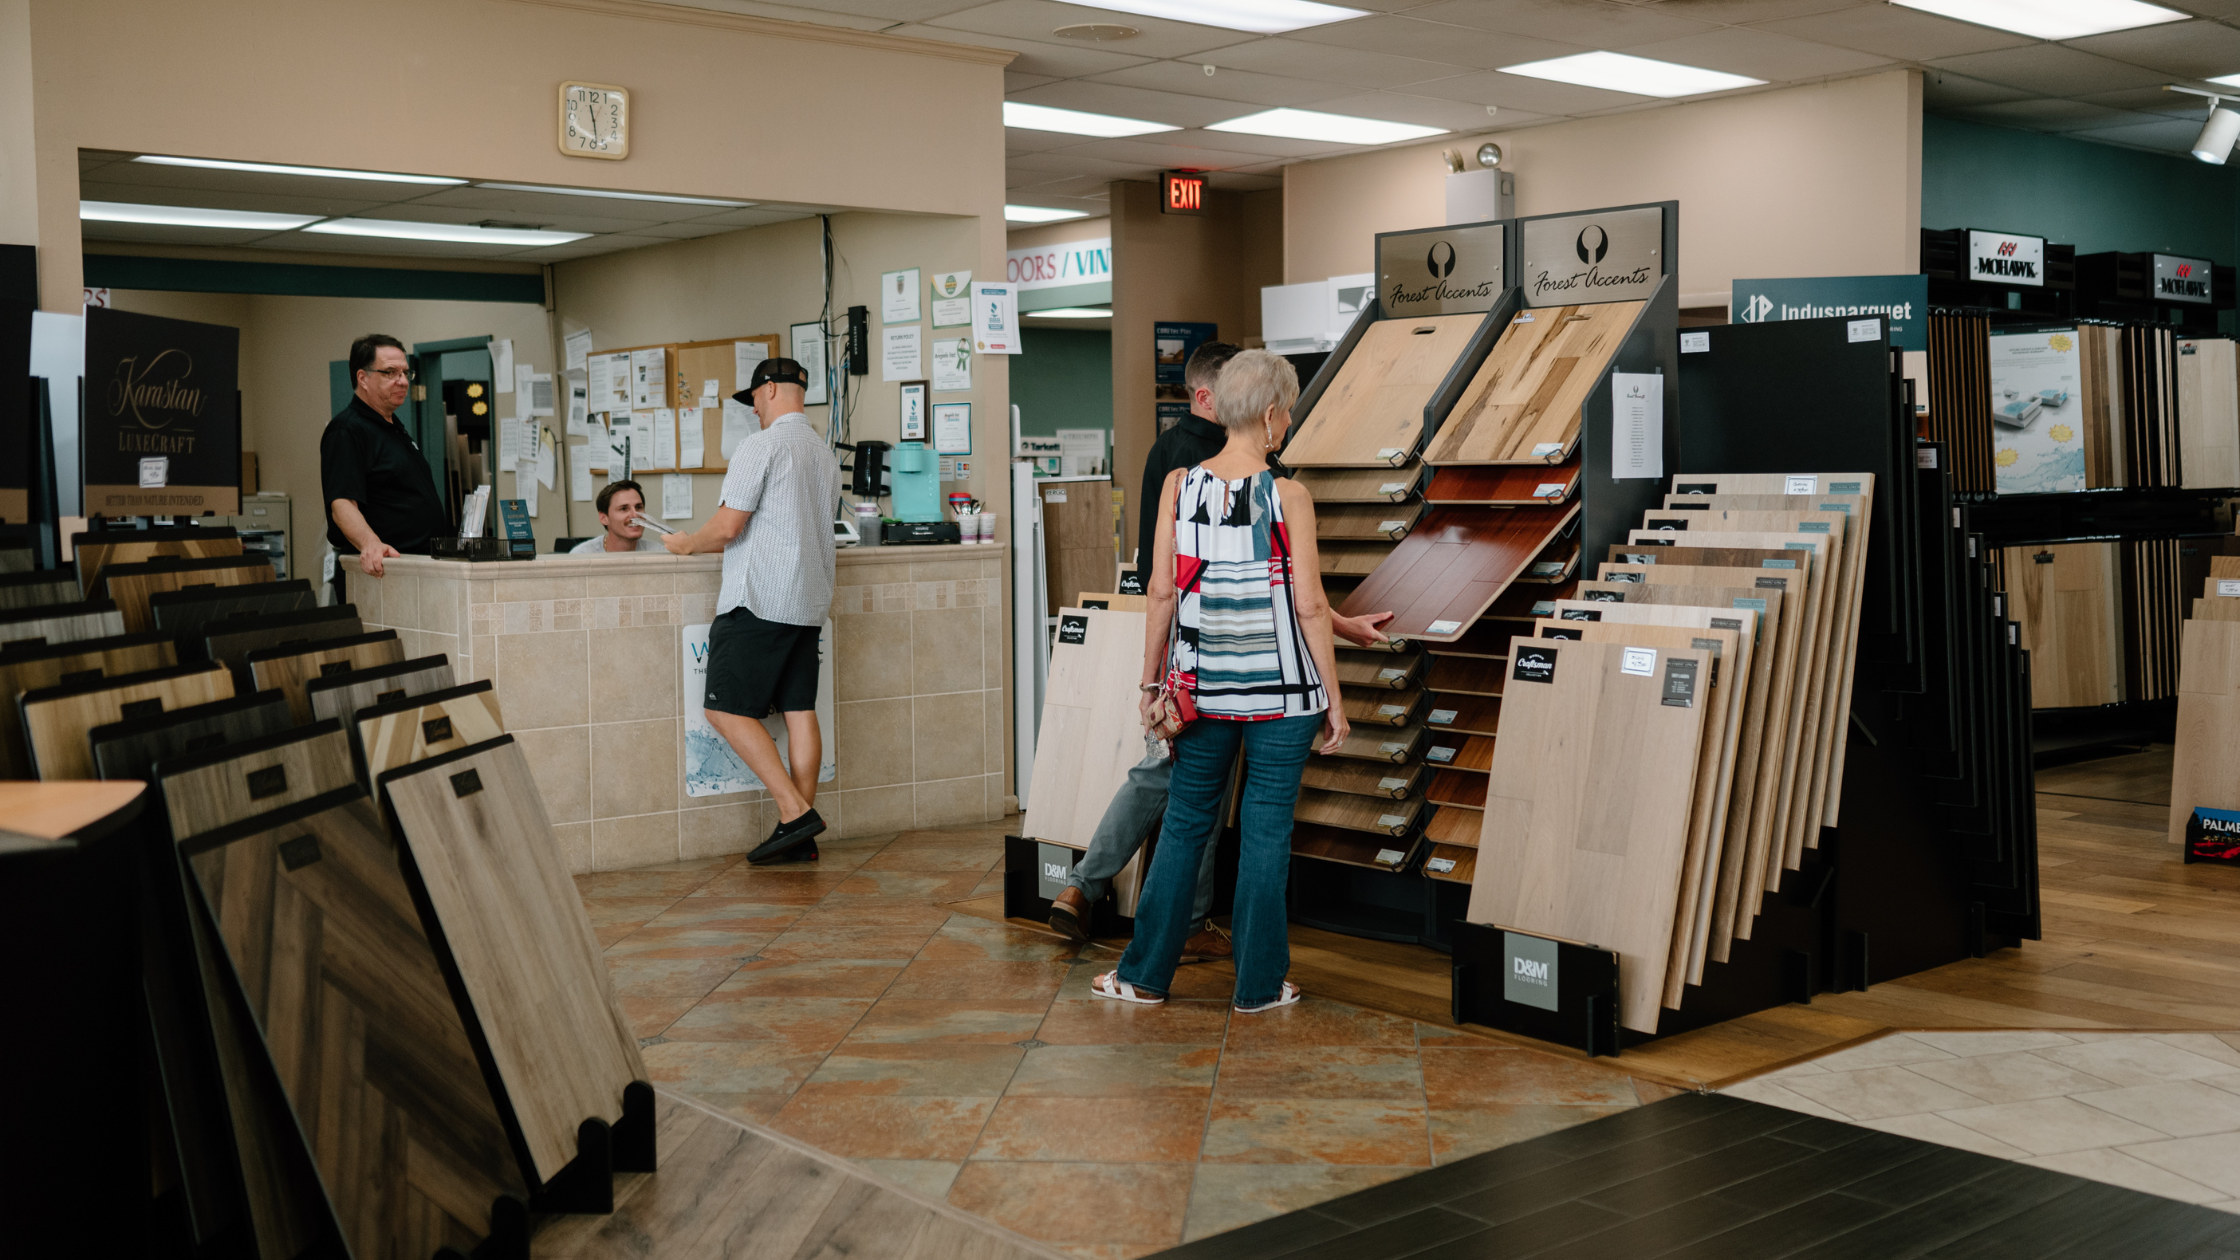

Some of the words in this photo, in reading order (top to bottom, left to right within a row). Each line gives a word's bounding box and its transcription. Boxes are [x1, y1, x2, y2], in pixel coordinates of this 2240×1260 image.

[578, 90, 586, 102] 11
[589, 92, 600, 104] 12
[567, 99, 578, 111] 10
[611, 104, 618, 116] 2
[611, 117, 618, 129] 3
[568, 126, 576, 138] 8
[610, 130, 618, 140] 4
[579, 137, 586, 148] 7
[589, 139, 597, 150] 6
[600, 139, 608, 150] 5
[1170, 178, 1203, 210] EXIT
[1075, 247, 1112, 276] VIN
[1978, 257, 2036, 278] MOHAWK
[1534, 270, 1587, 296] Forest
[1585, 266, 1651, 290] Accents
[2161, 278, 2207, 297] MOHAWK
[1390, 283, 1437, 308] Forest
[1435, 280, 1494, 301] Accents
[107, 349, 207, 429] Karastan
[119, 432, 195, 453] LUXECRAFT
[1031, 443, 1060, 452] Tarkett
[1121, 580, 1140, 588] Craftsm
[1062, 625, 1084, 634] Craftsman
[1518, 658, 1552, 669] Craftsman
[1045, 862, 1066, 880] D&M
[1514, 956, 1548, 980] D&M
[1514, 974, 1548, 986] FLOORING
